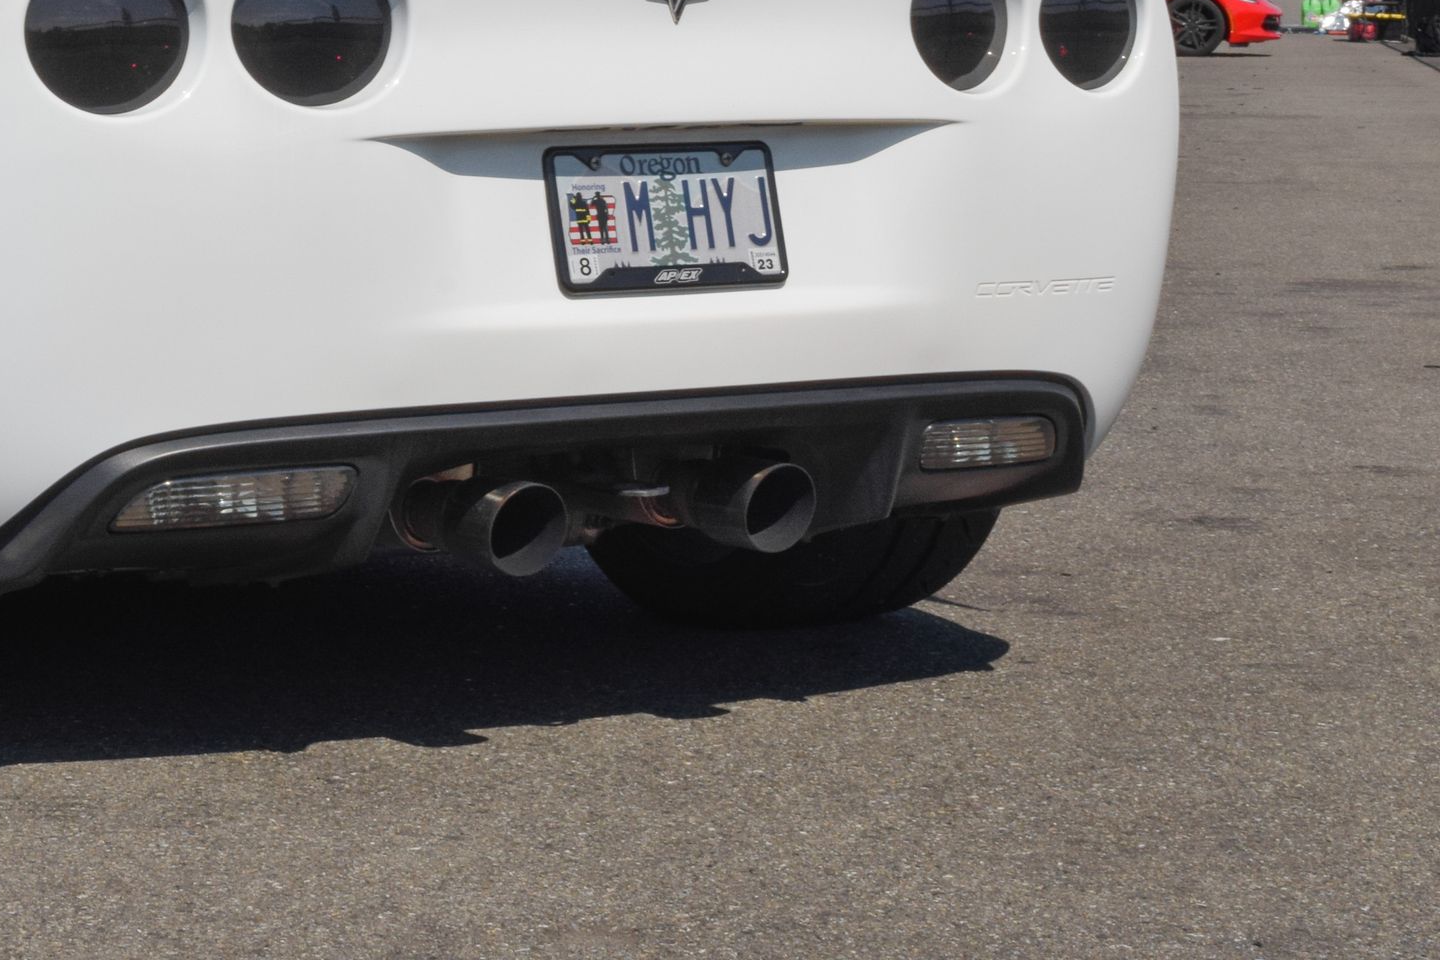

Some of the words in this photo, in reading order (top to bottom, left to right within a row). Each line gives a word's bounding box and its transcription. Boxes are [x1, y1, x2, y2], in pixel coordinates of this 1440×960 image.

[619, 153, 703, 181] Oregon
[571, 182, 606, 193] Honoring
[622, 179, 657, 253] M
[572, 245, 591, 255] Their
[591, 244, 622, 255] Sacrifice
[578, 257, 593, 277] 8
[756, 258, 774, 271] 23
[975, 275, 1116, 298] CORVETTE
